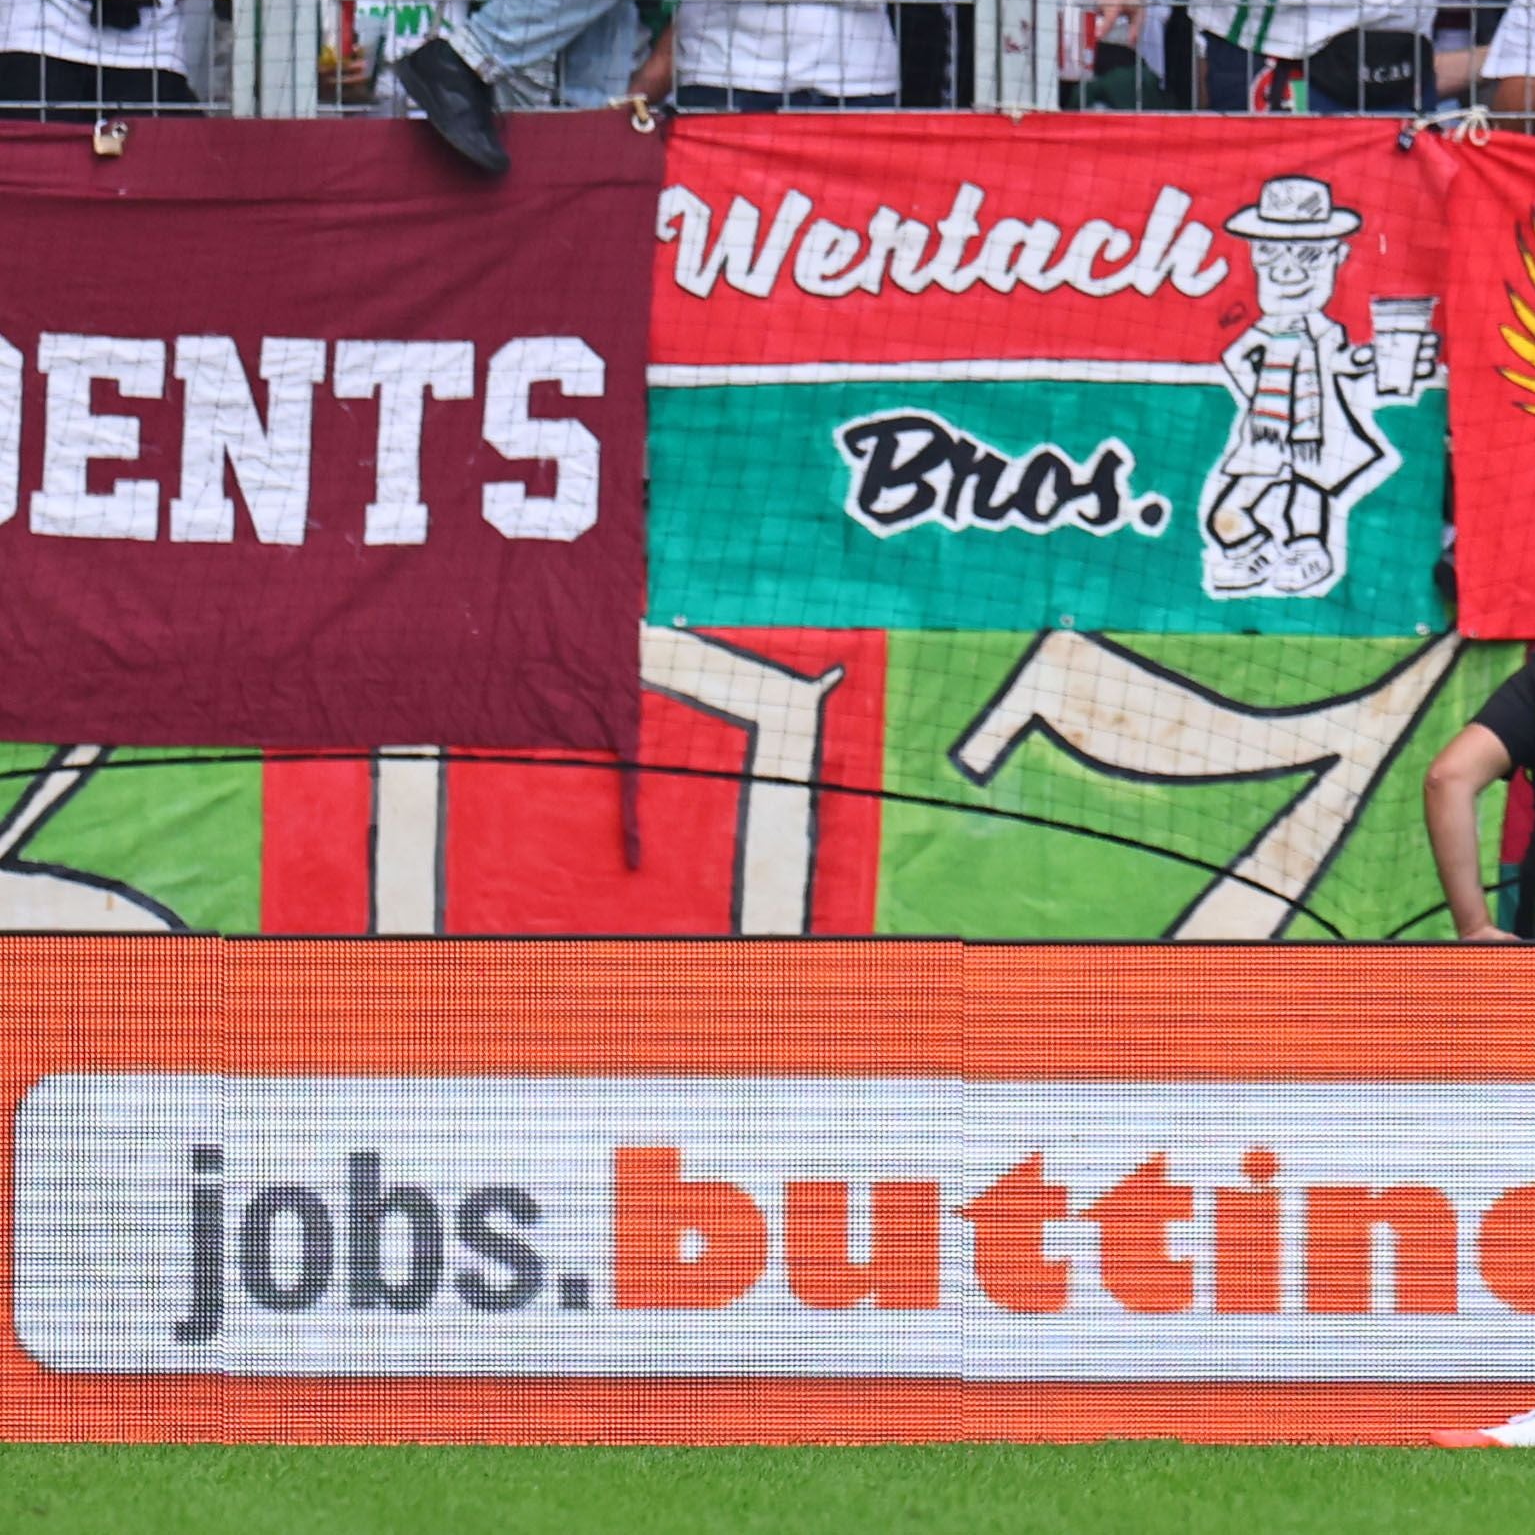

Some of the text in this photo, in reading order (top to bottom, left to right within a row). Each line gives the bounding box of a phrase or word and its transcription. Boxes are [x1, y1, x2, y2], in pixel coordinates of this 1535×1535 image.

[655, 182, 1229, 299] Wertach
[0, 331, 606, 545] ENTS
[841, 411, 1169, 531] Bros.
